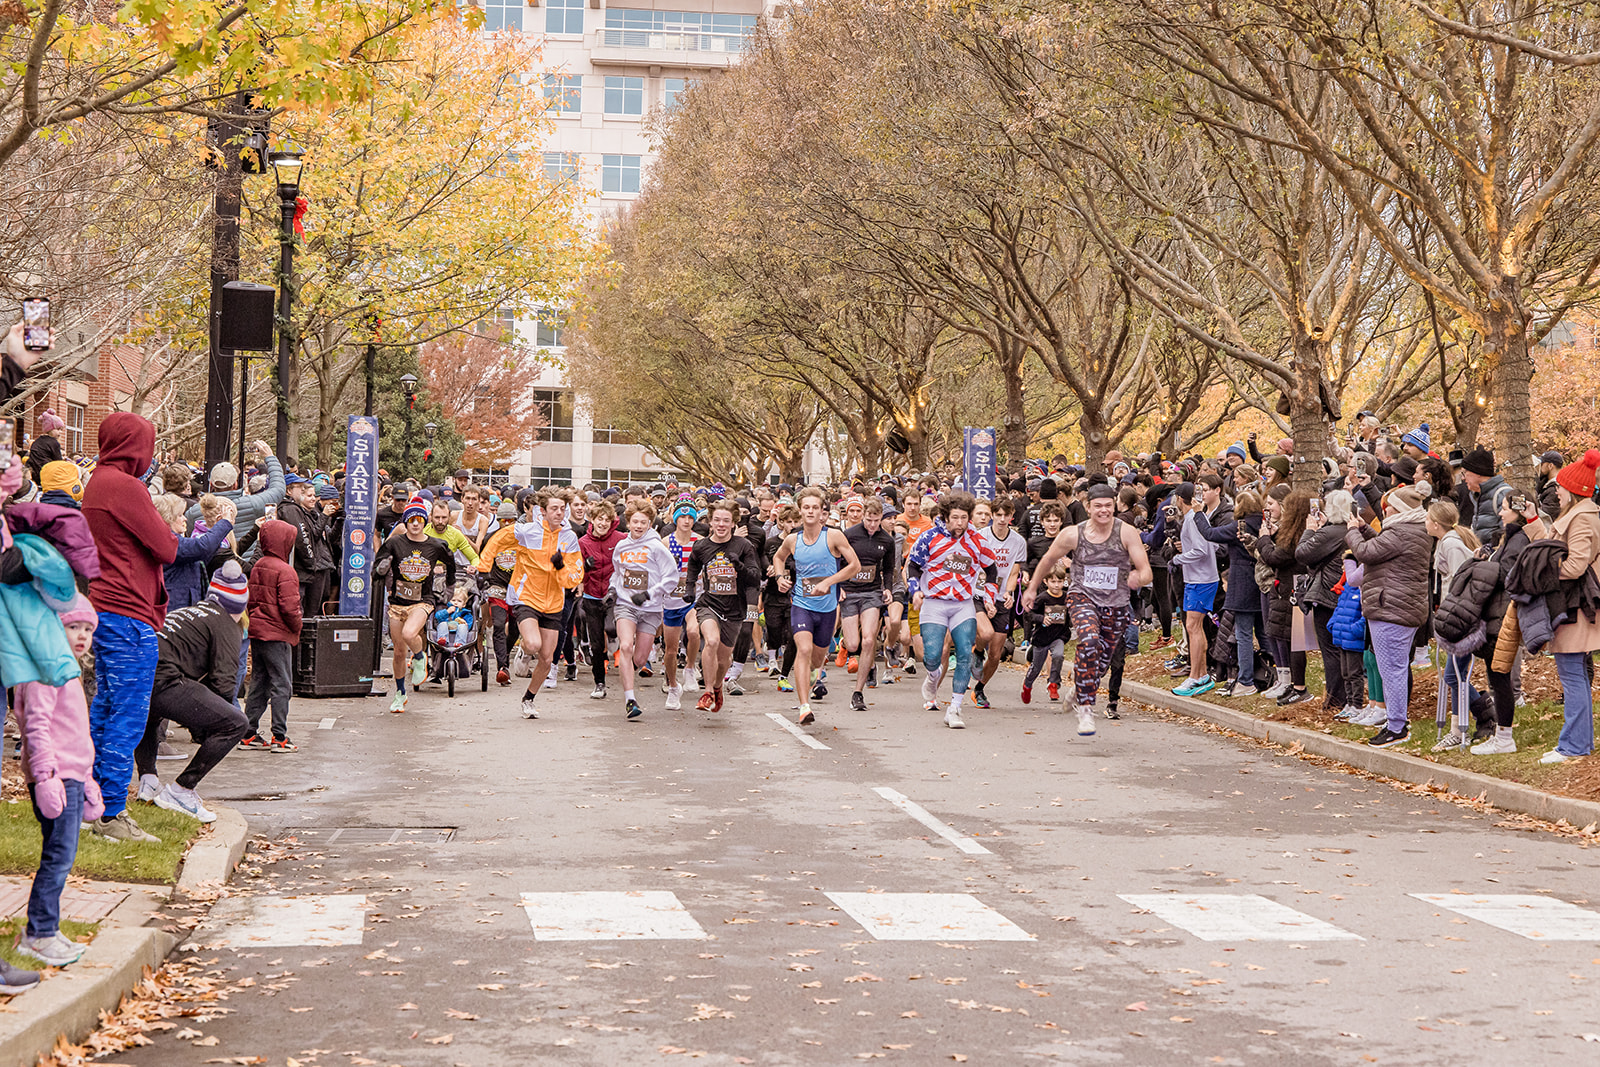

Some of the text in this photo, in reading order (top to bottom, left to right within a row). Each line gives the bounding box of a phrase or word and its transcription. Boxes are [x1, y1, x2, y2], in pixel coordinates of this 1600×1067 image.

[351, 439, 369, 503] START
[657, 473, 676, 481] 4000
[947, 561, 967, 571] 3698
[1086, 569, 1116, 584] GOGGINS
[628, 577, 642, 586] 799
[714, 582, 732, 591] 1678
[404, 587, 412, 596] 70
